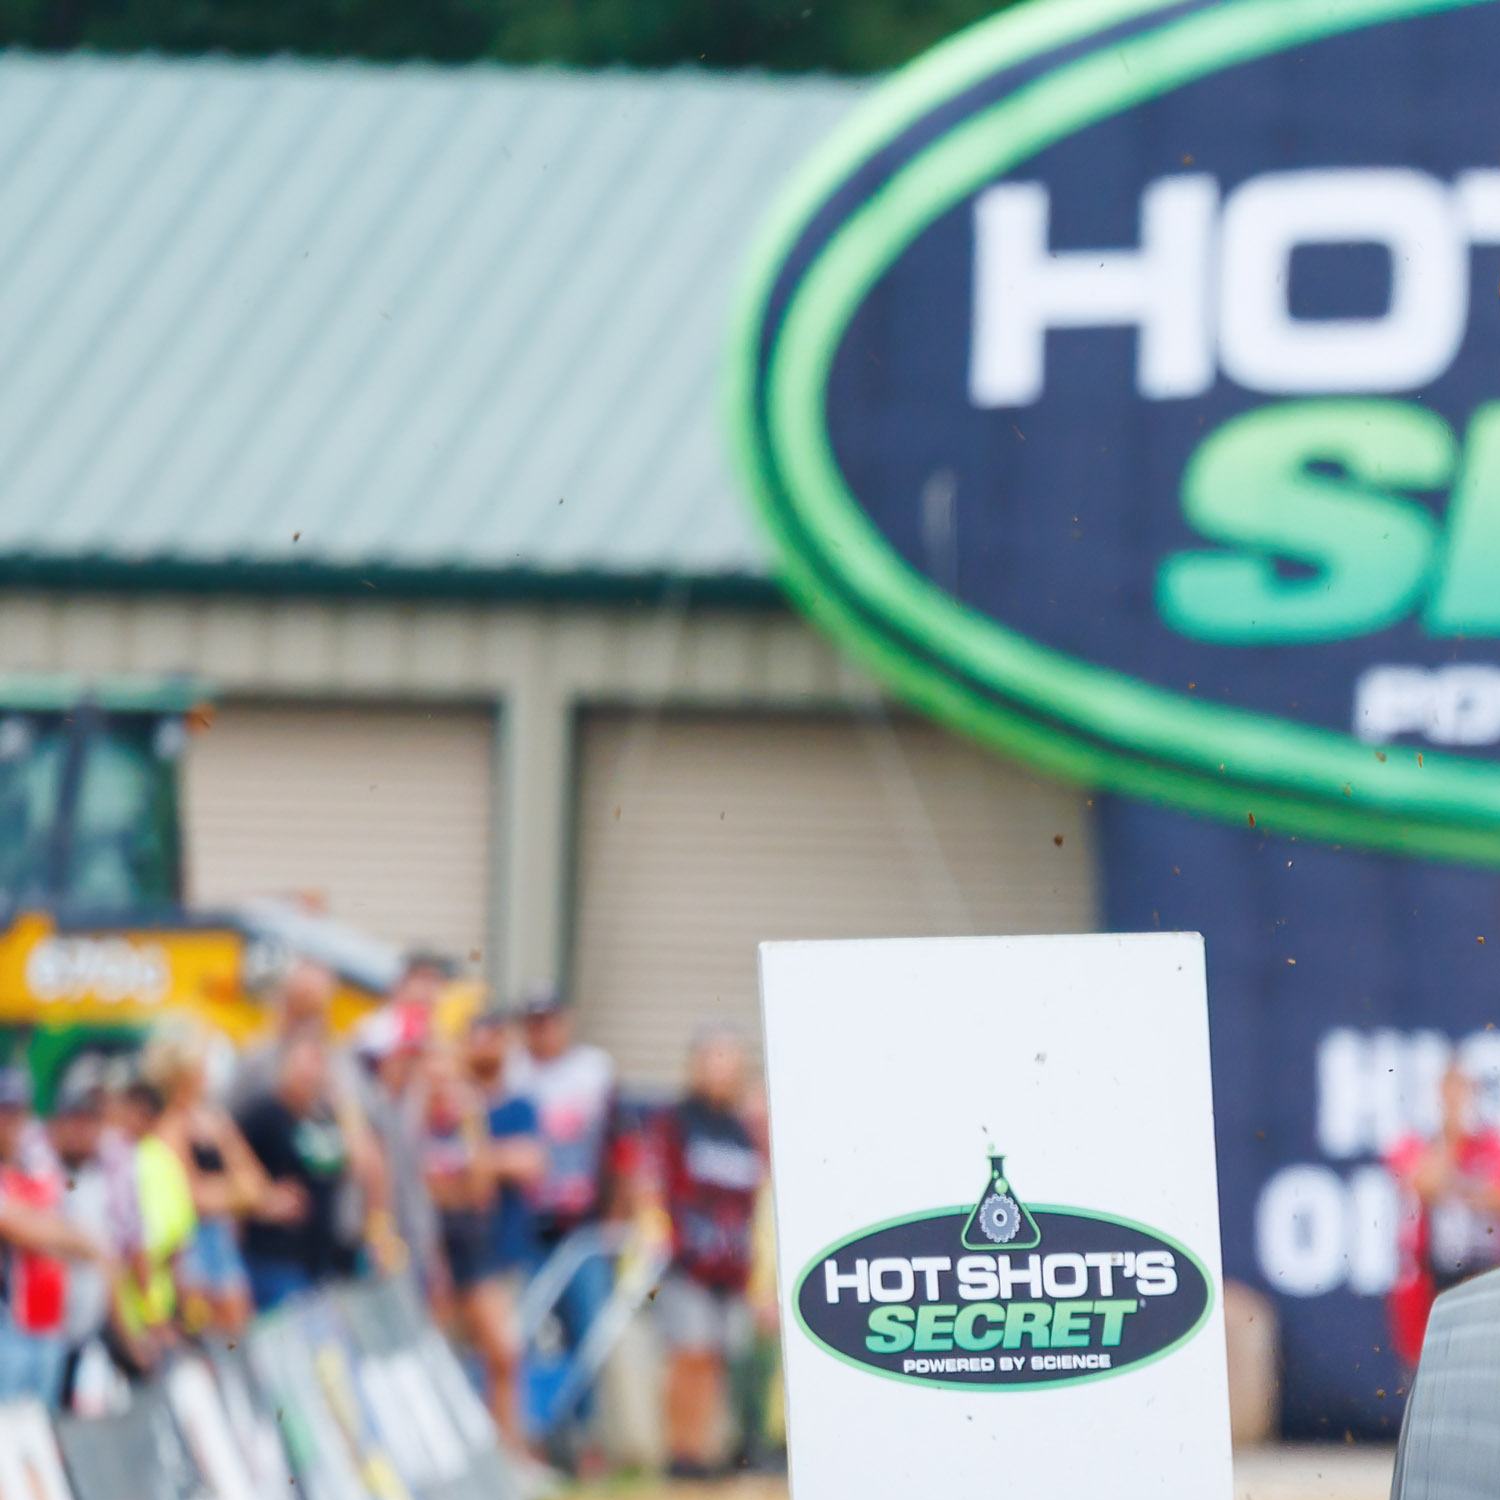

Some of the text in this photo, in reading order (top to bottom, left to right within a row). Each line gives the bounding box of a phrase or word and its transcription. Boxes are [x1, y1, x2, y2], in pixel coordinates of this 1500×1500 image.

[824, 1250, 1179, 1304] HOT SHOT'S
[866, 1299, 1138, 1354] SECRET
[903, 1354, 1112, 1374] POWERED BY SCIENCE
